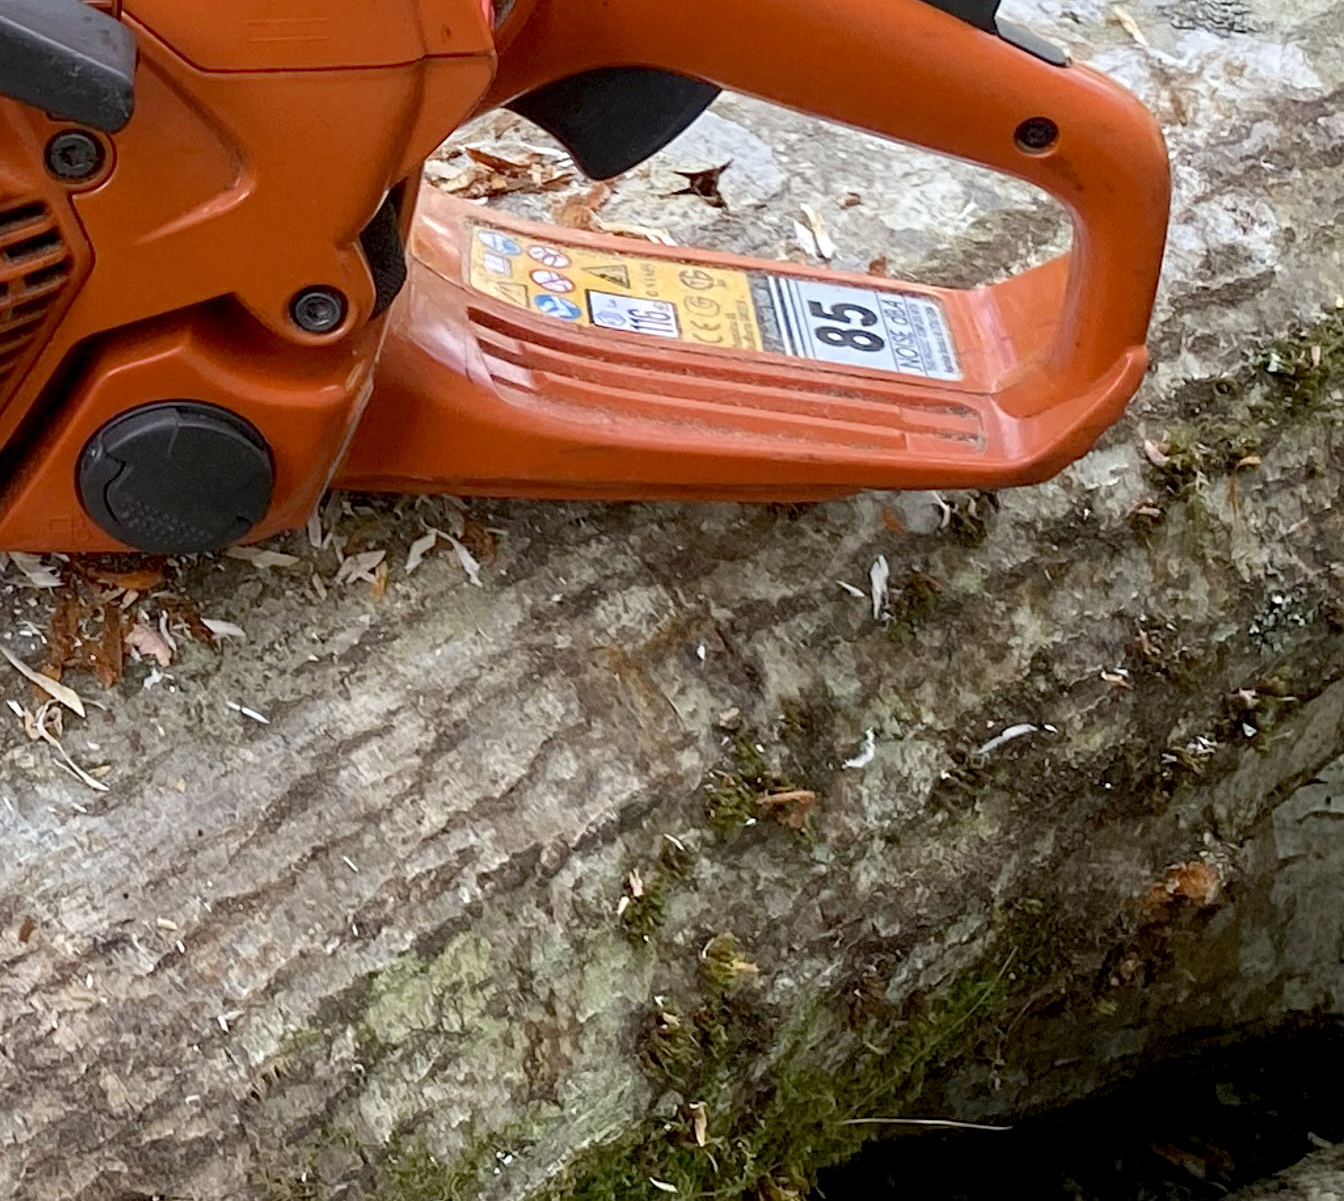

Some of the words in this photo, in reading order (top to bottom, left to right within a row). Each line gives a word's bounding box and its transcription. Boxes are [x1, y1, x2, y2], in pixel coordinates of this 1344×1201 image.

[627, 308, 675, 334] 116
[807, 300, 885, 353] 85
[889, 328, 923, 373] NOISE
